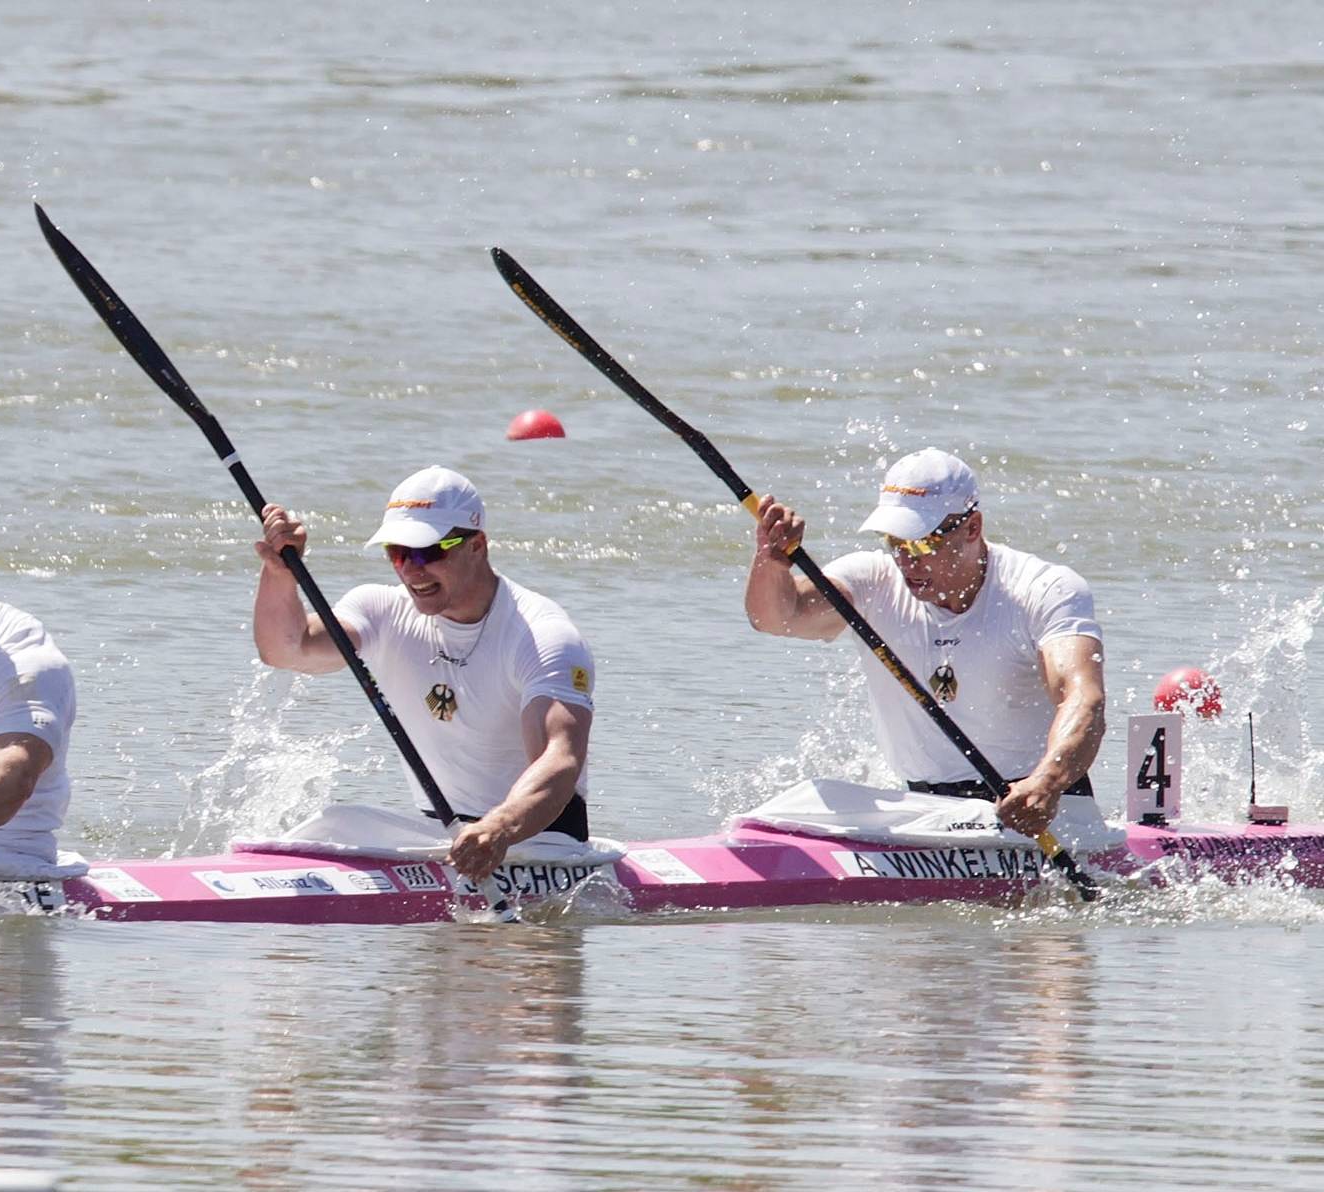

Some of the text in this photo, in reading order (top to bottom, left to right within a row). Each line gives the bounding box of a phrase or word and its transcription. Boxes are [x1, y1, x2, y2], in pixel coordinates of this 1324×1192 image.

[1137, 727, 1171, 808] 4
[854, 852, 888, 876] A.
[252, 877, 312, 890] Allianz
